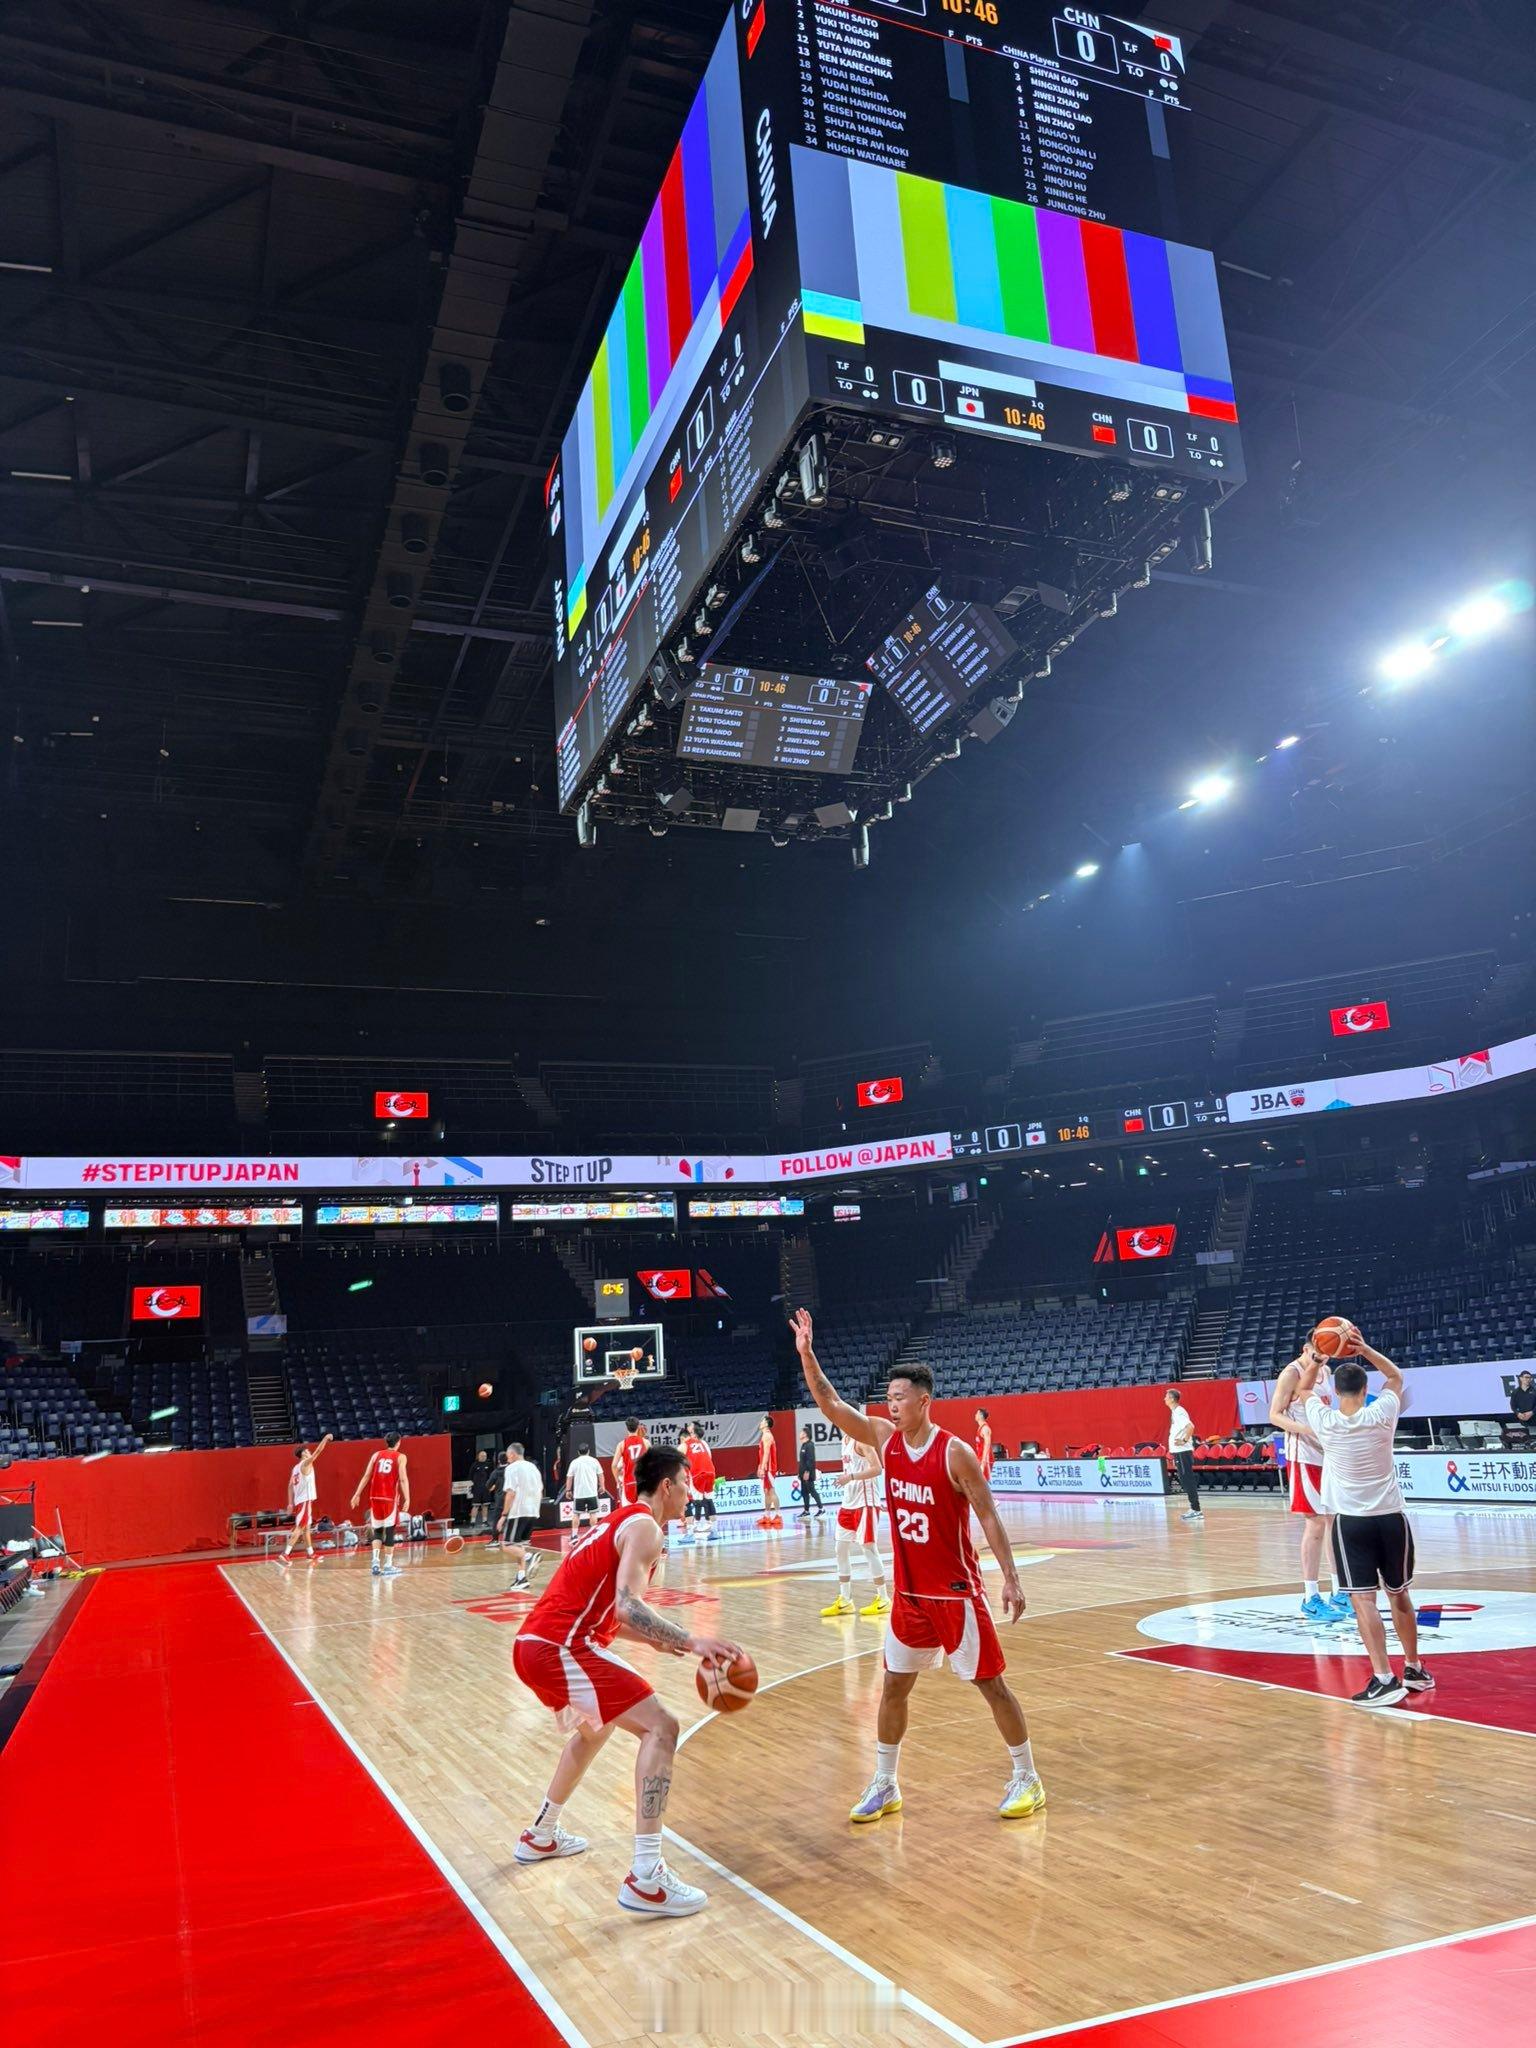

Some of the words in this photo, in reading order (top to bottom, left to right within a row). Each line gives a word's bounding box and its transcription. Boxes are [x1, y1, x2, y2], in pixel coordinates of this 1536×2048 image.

[814, 3, 849, 19] TAKUMI
[851, 14, 878, 28] SAITO
[815, 15, 837, 28] YUKI
[839, 22, 880, 40] TOGASHI
[1063, 7, 1100, 30] CHN
[797, 34, 809, 44] 12
[817, 40, 842, 54] YUTA
[842, 47, 892, 67] WATANABE
[816, 28, 842, 41] SEIYA
[844, 36, 871, 49] ANDO
[948, 30, 954, 38] F
[966, 35, 983, 47] PTS
[1076, 31, 1096, 62] 0
[798, 47, 810, 56] 13
[819, 53, 838, 65] REN
[840, 58, 893, 80] KANECHIKA
[1002, 46, 1029, 60] CHINA
[1030, 53, 1060, 68] Players
[1123, 41, 1138, 53] T.F
[1160, 53, 1170, 71] 0
[800, 60, 811, 68] 18
[820, 65, 848, 79] YUDAI
[850, 73, 875, 86] BABA
[1029, 66, 1060, 81] SHIYAN
[1061, 76, 1078, 87] GAO
[1126, 65, 1144, 77] T.O
[801, 72, 812, 81] 19
[820, 77, 849, 92] YUDAI
[851, 86, 889, 102] NISHIDA
[1016, 85, 1022, 93] 4
[1032, 90, 1055, 103] JIWEI
[1057, 97, 1080, 109] ZHAO
[1031, 78, 1075, 97] MINGXUAN
[1076, 91, 1089, 101] HU
[801, 85, 813, 94] 24
[822, 91, 847, 104] JOSH
[849, 98, 906, 119] HAWKINSON
[1018, 97, 1024, 105] 5
[1034, 102, 1072, 118] SANNING
[1073, 113, 1092, 124] LIAO
[1164, 95, 1180, 105] PTS
[802, 97, 814, 107] 30
[823, 103, 853, 117] KEISEI
[855, 111, 904, 131] TOMINAGA
[804, 110, 815, 120] 31
[825, 116, 856, 131] SHUTA
[858, 125, 883, 138] HARA
[1020, 109, 1025, 117] 8
[1035, 113, 1050, 124] RUI
[1052, 118, 1075, 131] ZHAO
[804, 123, 817, 133] 32
[826, 129, 868, 147] SCHAFER
[870, 140, 885, 150] AVI
[886, 144, 909, 157] KOKI
[1019, 120, 1029, 130] 11
[1037, 126, 1068, 140] JIAHAO
[1069, 134, 1080, 144] YU
[806, 136, 818, 146] 34
[827, 141, 855, 155] HUGH
[856, 149, 906, 169] WATANABE
[1020, 132, 1031, 142] 14
[1038, 138, 1087, 158] HONGQUAN
[1088, 151, 1097, 160] LI
[1022, 145, 1032, 154] 16
[1040, 149, 1073, 165] BOQIAO
[1075, 159, 1094, 171] JIAO
[756, 108, 777, 240] CHINA
[1023, 157, 1033, 166] 17
[1042, 162, 1062, 174] JIAYI
[1063, 167, 1086, 180] ZHAO
[1024, 169, 1035, 179] 21
[1043, 175, 1072, 188] JINQIU
[1074, 182, 1087, 192] HU
[1026, 181, 1037, 191] 23
[1044, 187, 1074, 201] XINING
[1076, 194, 1088, 204] HE
[1027, 194, 1038, 203] 26
[1046, 199, 1087, 216] JUNLONG
[1088, 209, 1106, 221] ZHU
[836, 361, 850, 371] T.F
[865, 366, 874, 382] 0
[838, 381, 853, 390] T.O
[911, 378, 927, 405] 0
[960, 386, 980, 397] JPN
[695, 411, 704, 450] 0
[1004, 408, 1045, 430] 10:46
[1092, 412, 1112, 424] CHN
[1144, 426, 1157, 451] 0
[1210, 437, 1218, 451] 0
[732, 668, 750, 676] JPN
[818, 679, 836, 687] CHN
[733, 678, 743, 693] 0
[759, 681, 786, 694] 10:46
[819, 688, 829, 703] 0
[1163, 1106, 1175, 1127] 0
[1216, 1099, 1223, 1110] 0
[1250, 1092, 1289, 1111] JBA
[998, 1128, 1009, 1148] 0
[1027, 1122, 1042, 1130] JPN
[1058, 1125, 1090, 1142] 10:46
[530, 1157, 570, 1183] STEP
[574, 1160, 585, 1183] IT
[588, 1157, 612, 1182] UP
[781, 1151, 853, 1175] FOLLOW
[858, 1141, 952, 1165] @JAPAN_
[82, 1164, 300, 1182] #STEPITUPJAPAN
[378, 1458, 393, 1473] 16
[1112, 1465, 1150, 1478] 三井不動産
[715, 1484, 761, 1500] 井不動産
[890, 1478, 935, 1505] CHINA
[1472, 1483, 1501, 1491] MITSUI
[729, 1498, 762, 1507] FUDOSAN
[896, 1508, 929, 1544] 23
